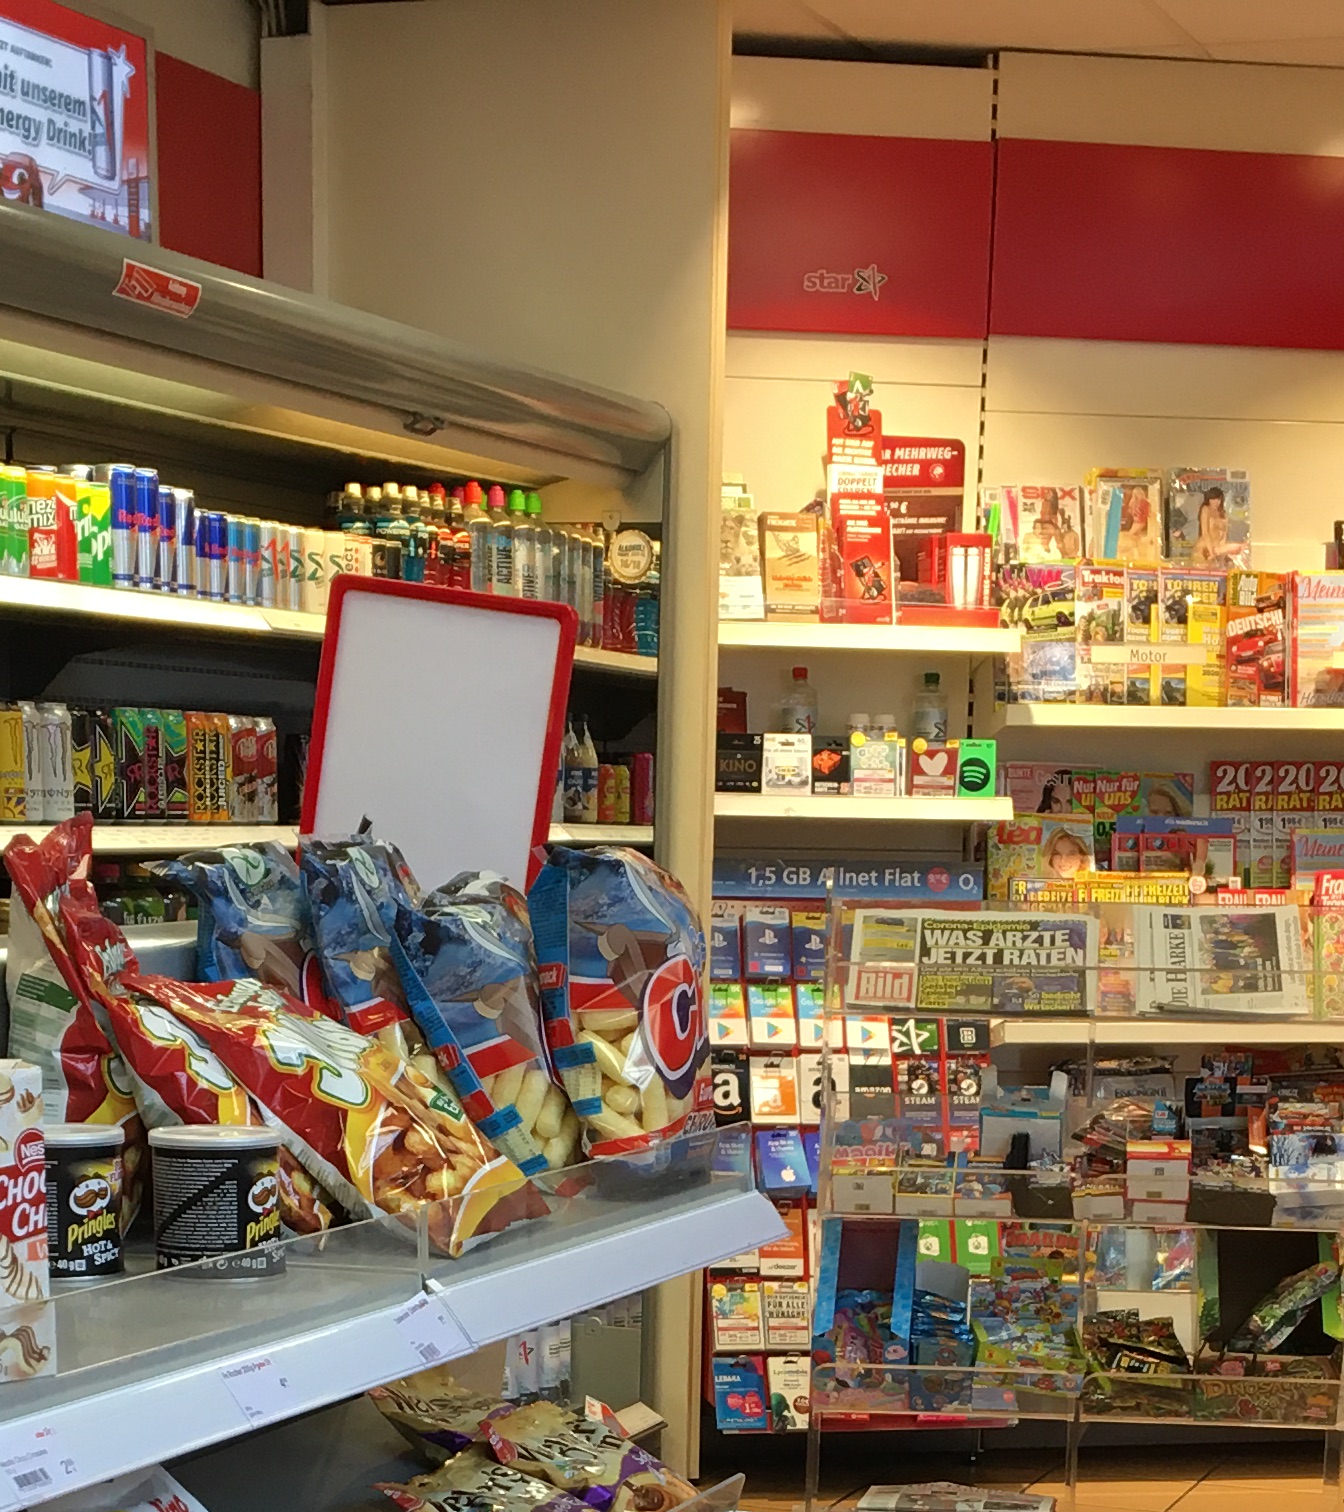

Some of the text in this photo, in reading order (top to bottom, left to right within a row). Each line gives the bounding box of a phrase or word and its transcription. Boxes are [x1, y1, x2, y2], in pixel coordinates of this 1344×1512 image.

[20, 79, 86, 118] unserem
[46, 118, 94, 156] Drink!
[804, 269, 852, 292] star
[894, 447, 958, 460] MEHRWEG-
[838, 478, 877, 486] DOPPELT
[496, 544, 513, 585] ACTIVE
[1129, 649, 1168, 663] Motor
[720, 758, 756, 773] KINO
[1096, 778, 1139, 792] Nur für
[1104, 791, 1131, 805] uns
[1296, 836, 1344, 857] Meine
[748, 868, 776, 888] 1,5
[782, 868, 810, 886] GB
[884, 868, 920, 886] Flat
[924, 921, 1030, 931] Corona-Epidemie
[924, 930, 983, 947] WAS
[922, 948, 1083, 966] JETZT RATEN
[860, 975, 909, 999] Bild
[714, 1073, 741, 1107] a
[905, 1097, 935, 1105] STEAM
[68, 1212, 116, 1252] Pringles
[94, 1247, 119, 1265] SPICY
[768, 1301, 783, 1309] FÜR
